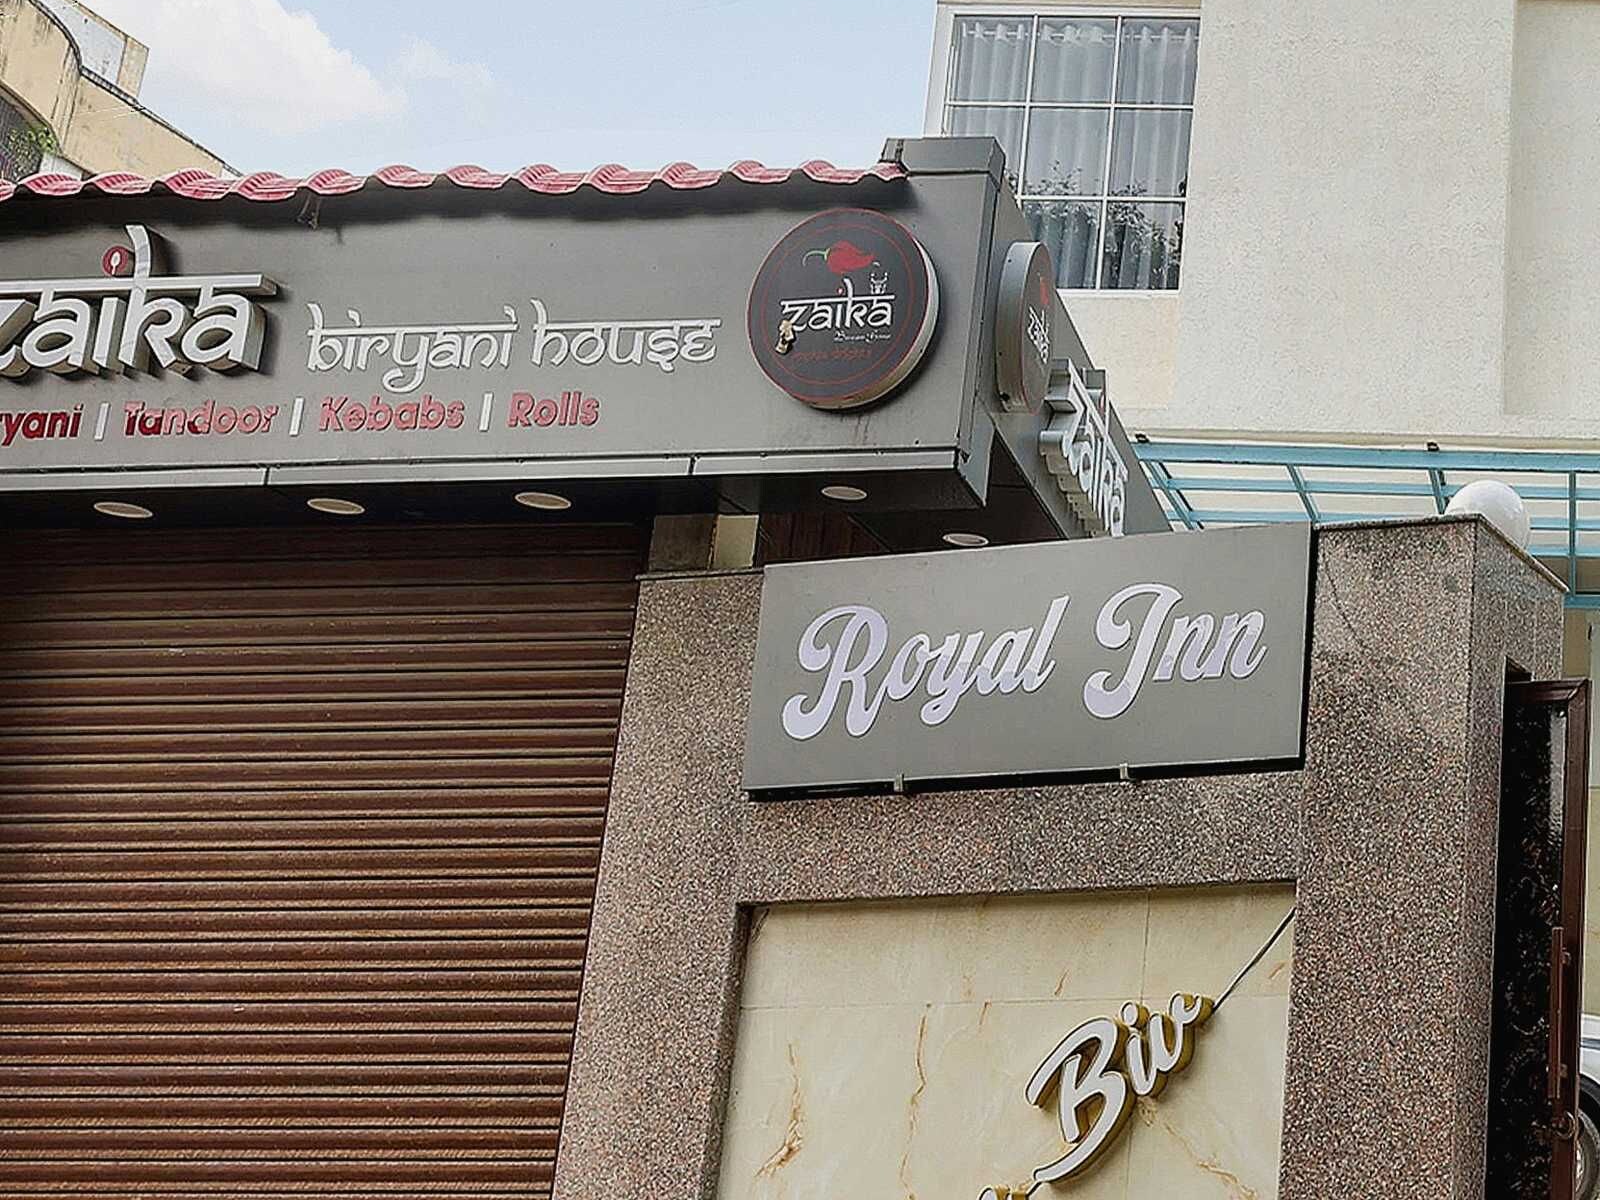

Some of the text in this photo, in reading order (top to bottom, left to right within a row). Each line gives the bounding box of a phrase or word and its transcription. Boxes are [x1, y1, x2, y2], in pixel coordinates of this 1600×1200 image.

[307, 299, 722, 393] biryani house
[0, 391, 601, 446] yani Tandoor Kebabs Rolls
[781, 583, 1267, 740] Royal Inn
